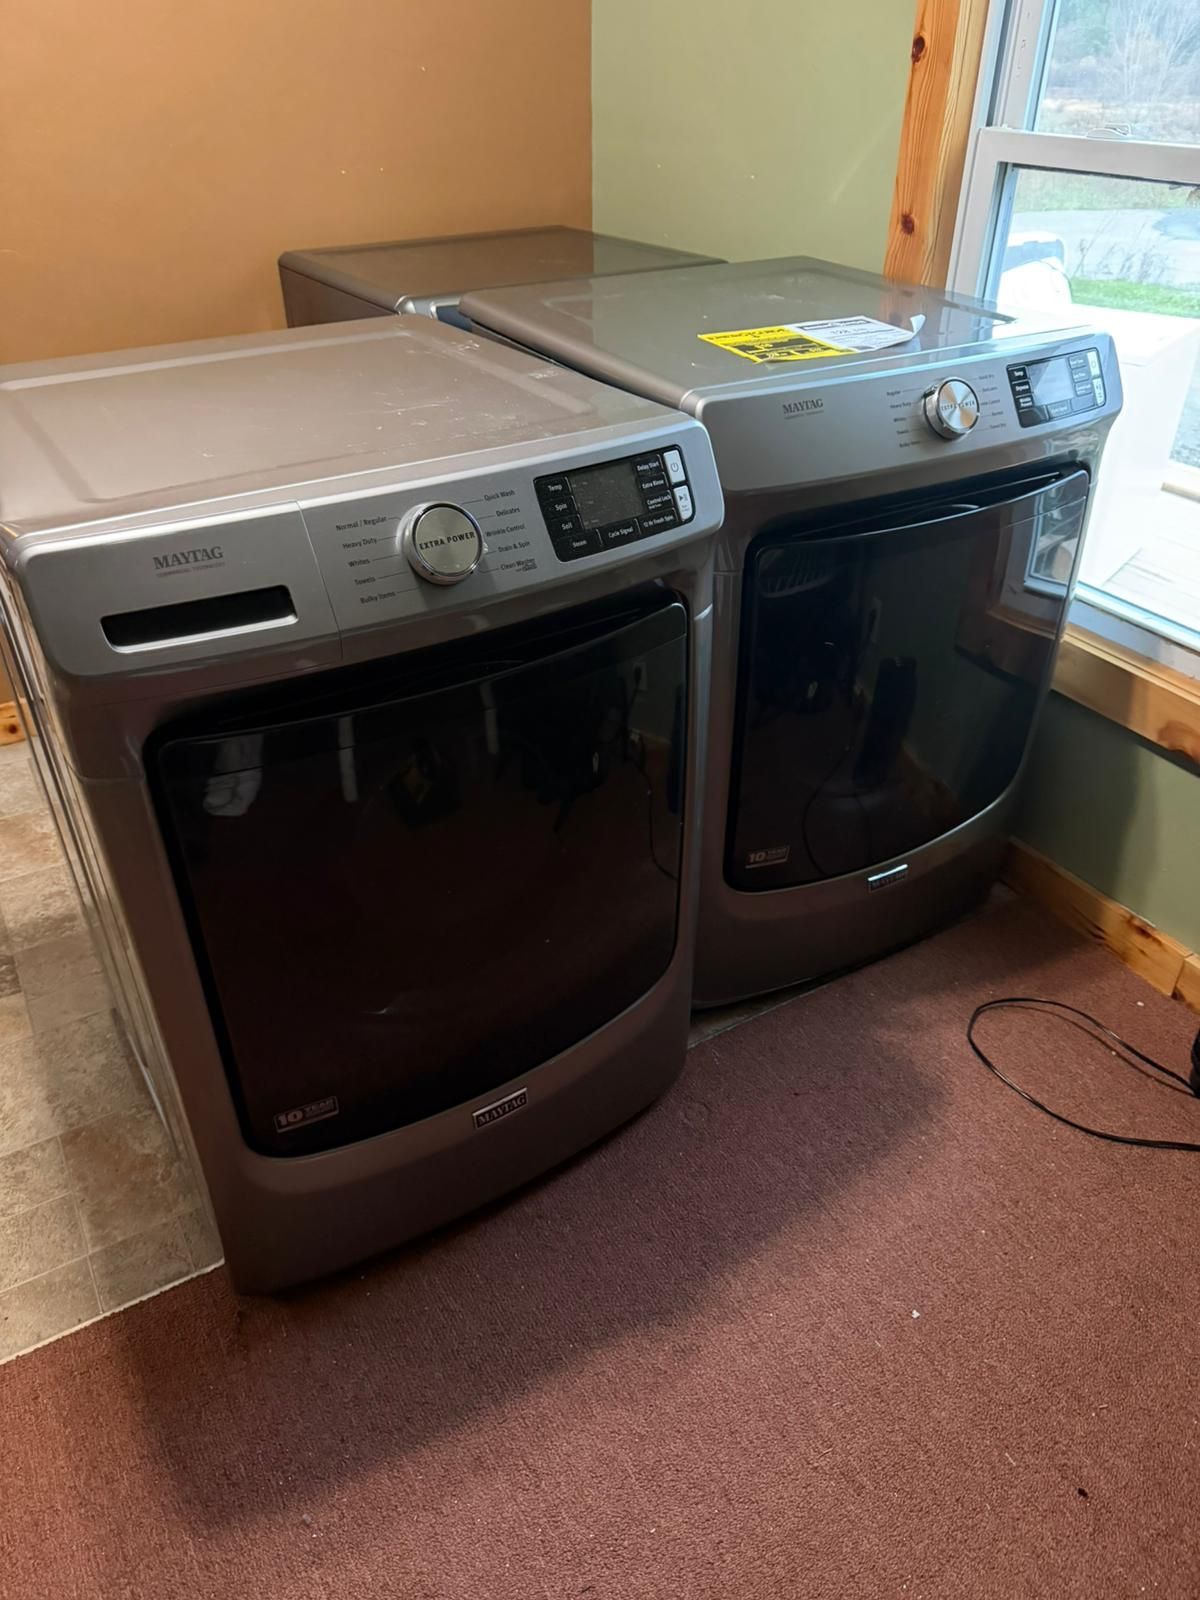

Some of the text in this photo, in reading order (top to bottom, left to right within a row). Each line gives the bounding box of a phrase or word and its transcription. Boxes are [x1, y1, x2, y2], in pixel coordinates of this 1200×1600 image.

[782, 399, 824, 414] MAYTAG
[548, 484, 563, 492] Temp
[484, 492, 499, 501] Quick
[496, 507, 520, 517] Delicates
[555, 503, 568, 511] Spin
[335, 522, 359, 531] Normal
[363, 516, 387, 526] Regular
[486, 523, 526, 537] Wrinkle Control
[419, 531, 476, 550] EXTRA POWER
[498, 545, 512, 553] Drain
[152, 546, 224, 570] MAYTAG
[348, 559, 371, 567] Whites
[354, 577, 376, 585] Towels
[360, 596, 378, 604] Bulky
[749, 852, 766, 862] 10
[478, 1094, 526, 1123] MAYTAG
[278, 1110, 303, 1126] 10
